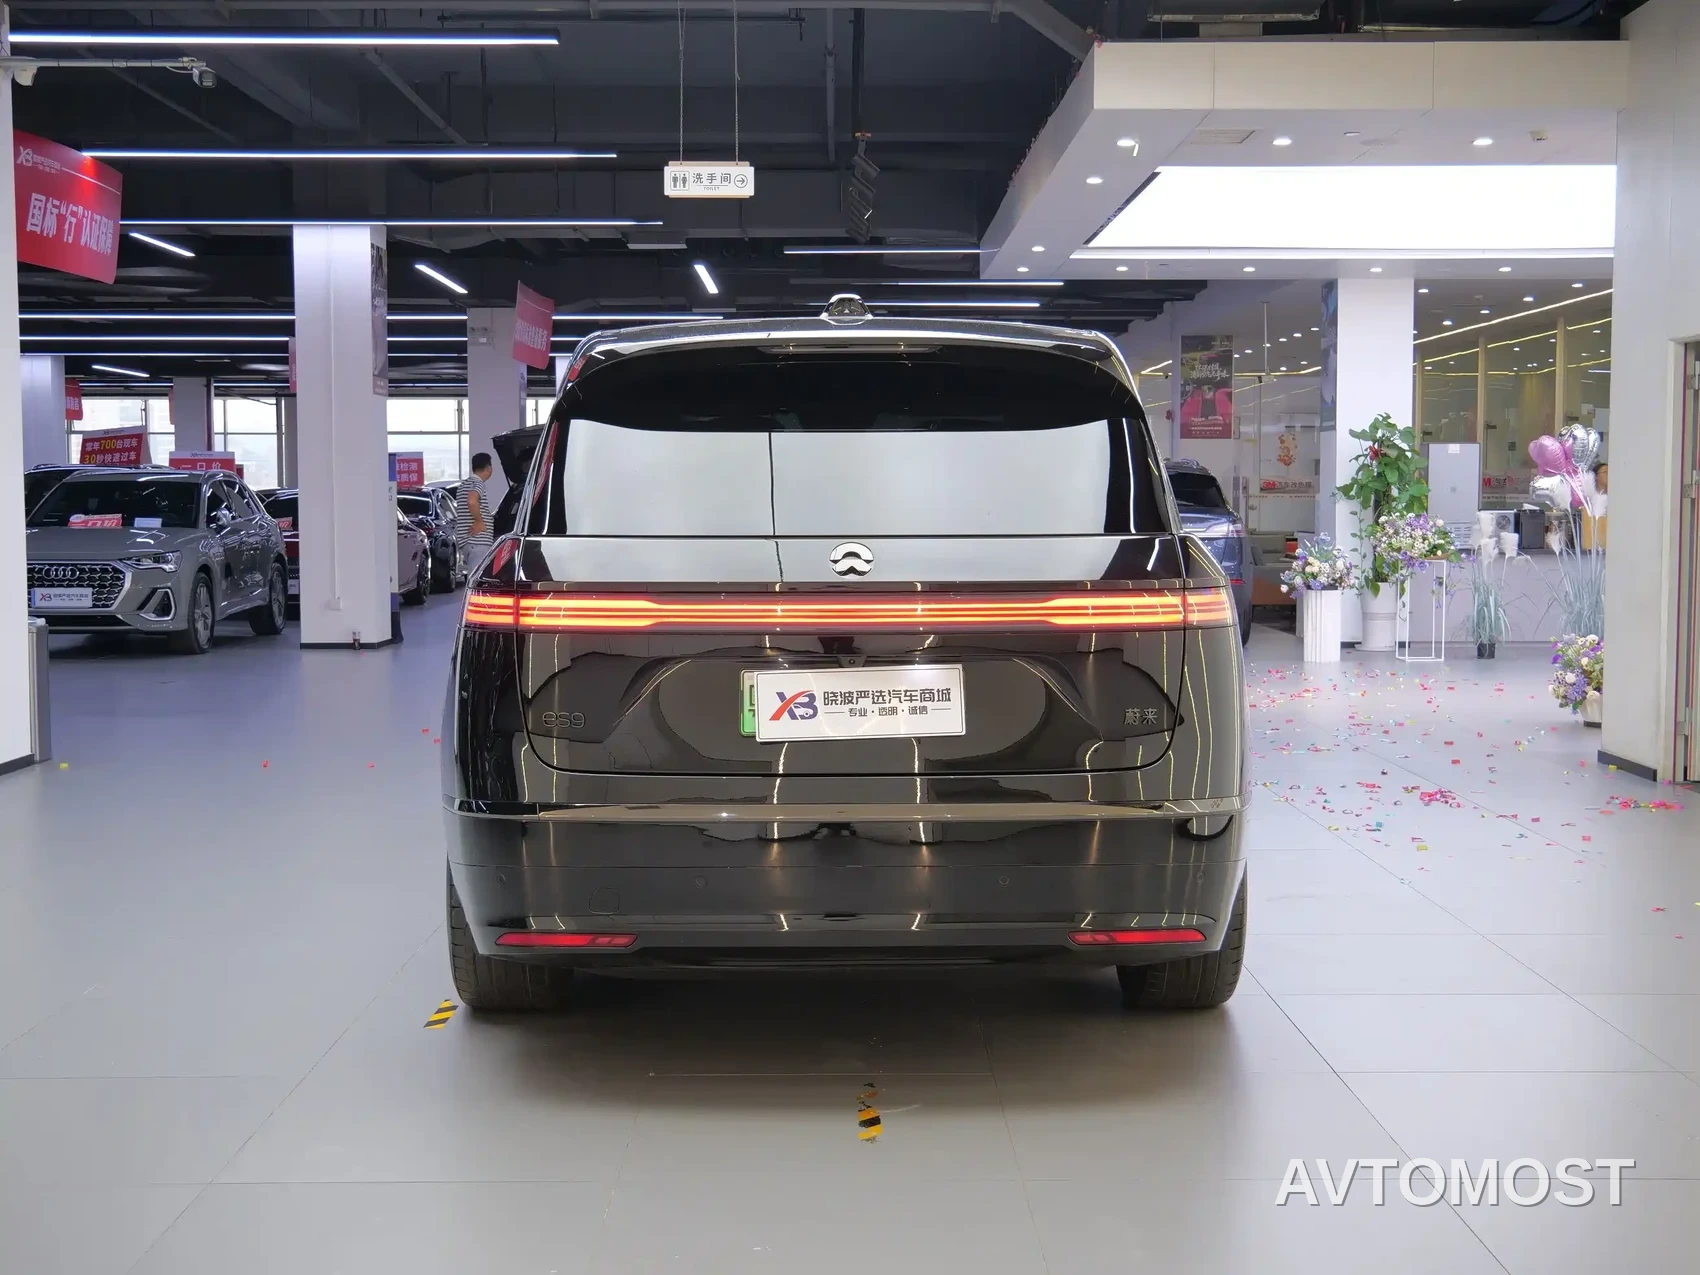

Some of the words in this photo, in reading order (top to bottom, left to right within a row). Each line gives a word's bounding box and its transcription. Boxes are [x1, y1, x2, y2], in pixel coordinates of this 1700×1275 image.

[692, 172, 731, 184] 洗手间
[769, 689, 818, 721] XB
[823, 687, 952, 706] 晓波严选汽车商城
[1124, 707, 1158, 725] 蔚来
